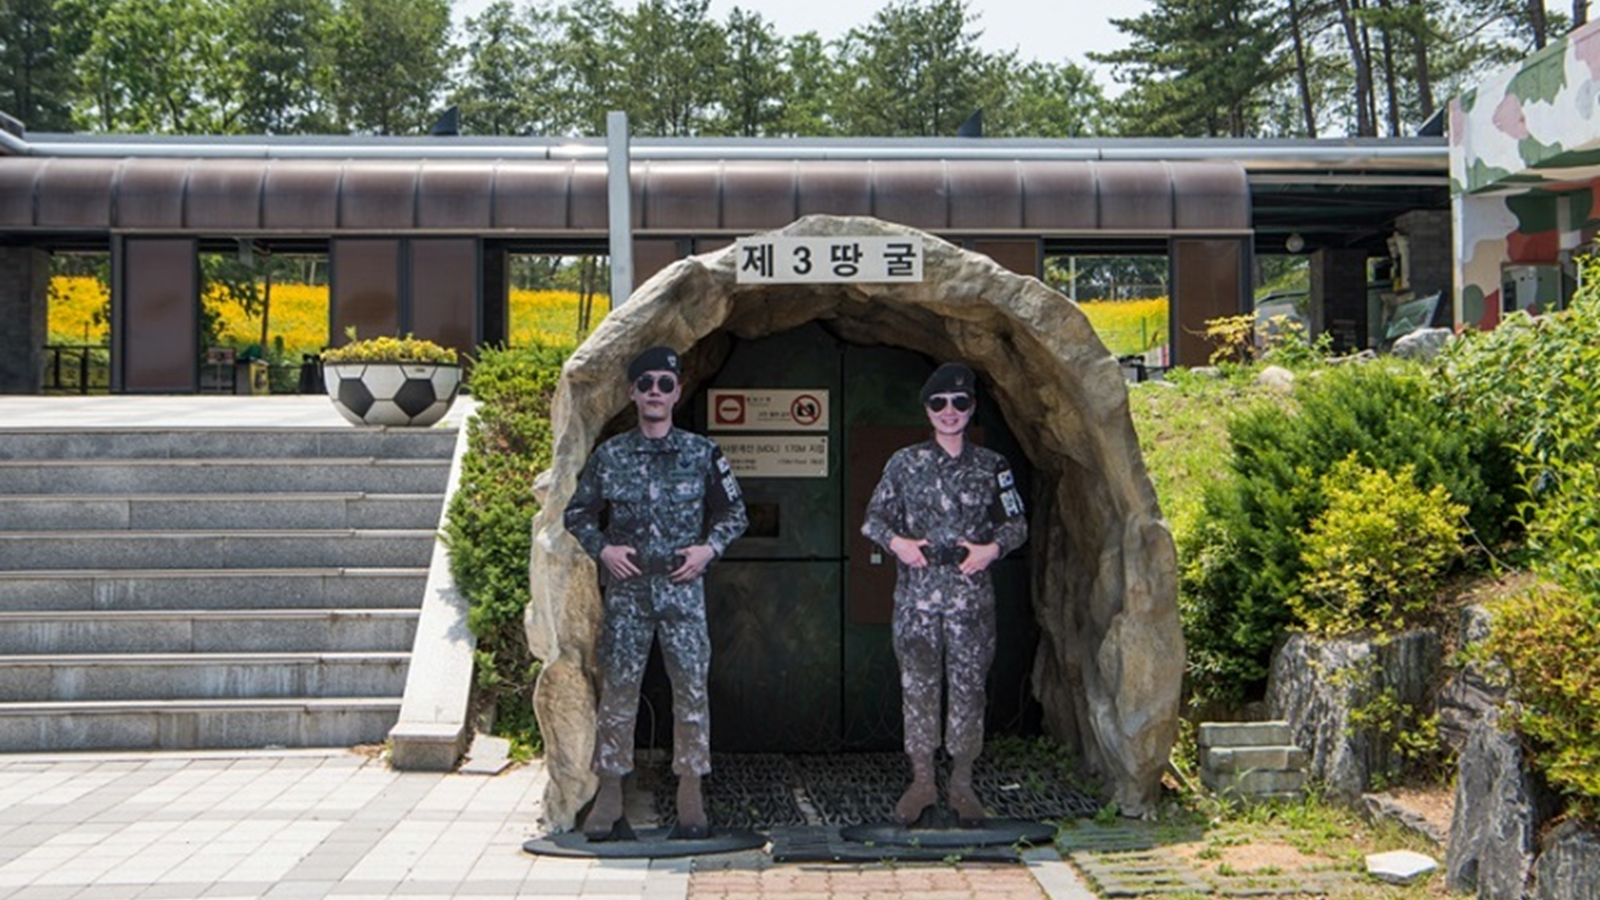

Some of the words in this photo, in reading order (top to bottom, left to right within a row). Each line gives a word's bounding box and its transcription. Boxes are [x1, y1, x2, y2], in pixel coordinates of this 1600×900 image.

[742, 243, 774, 277] 제
[792, 245, 812, 275] 3
[830, 242, 863, 277] 땅
[883, 243, 917, 276] 굴
[722, 443, 754, 454] 사분계선
